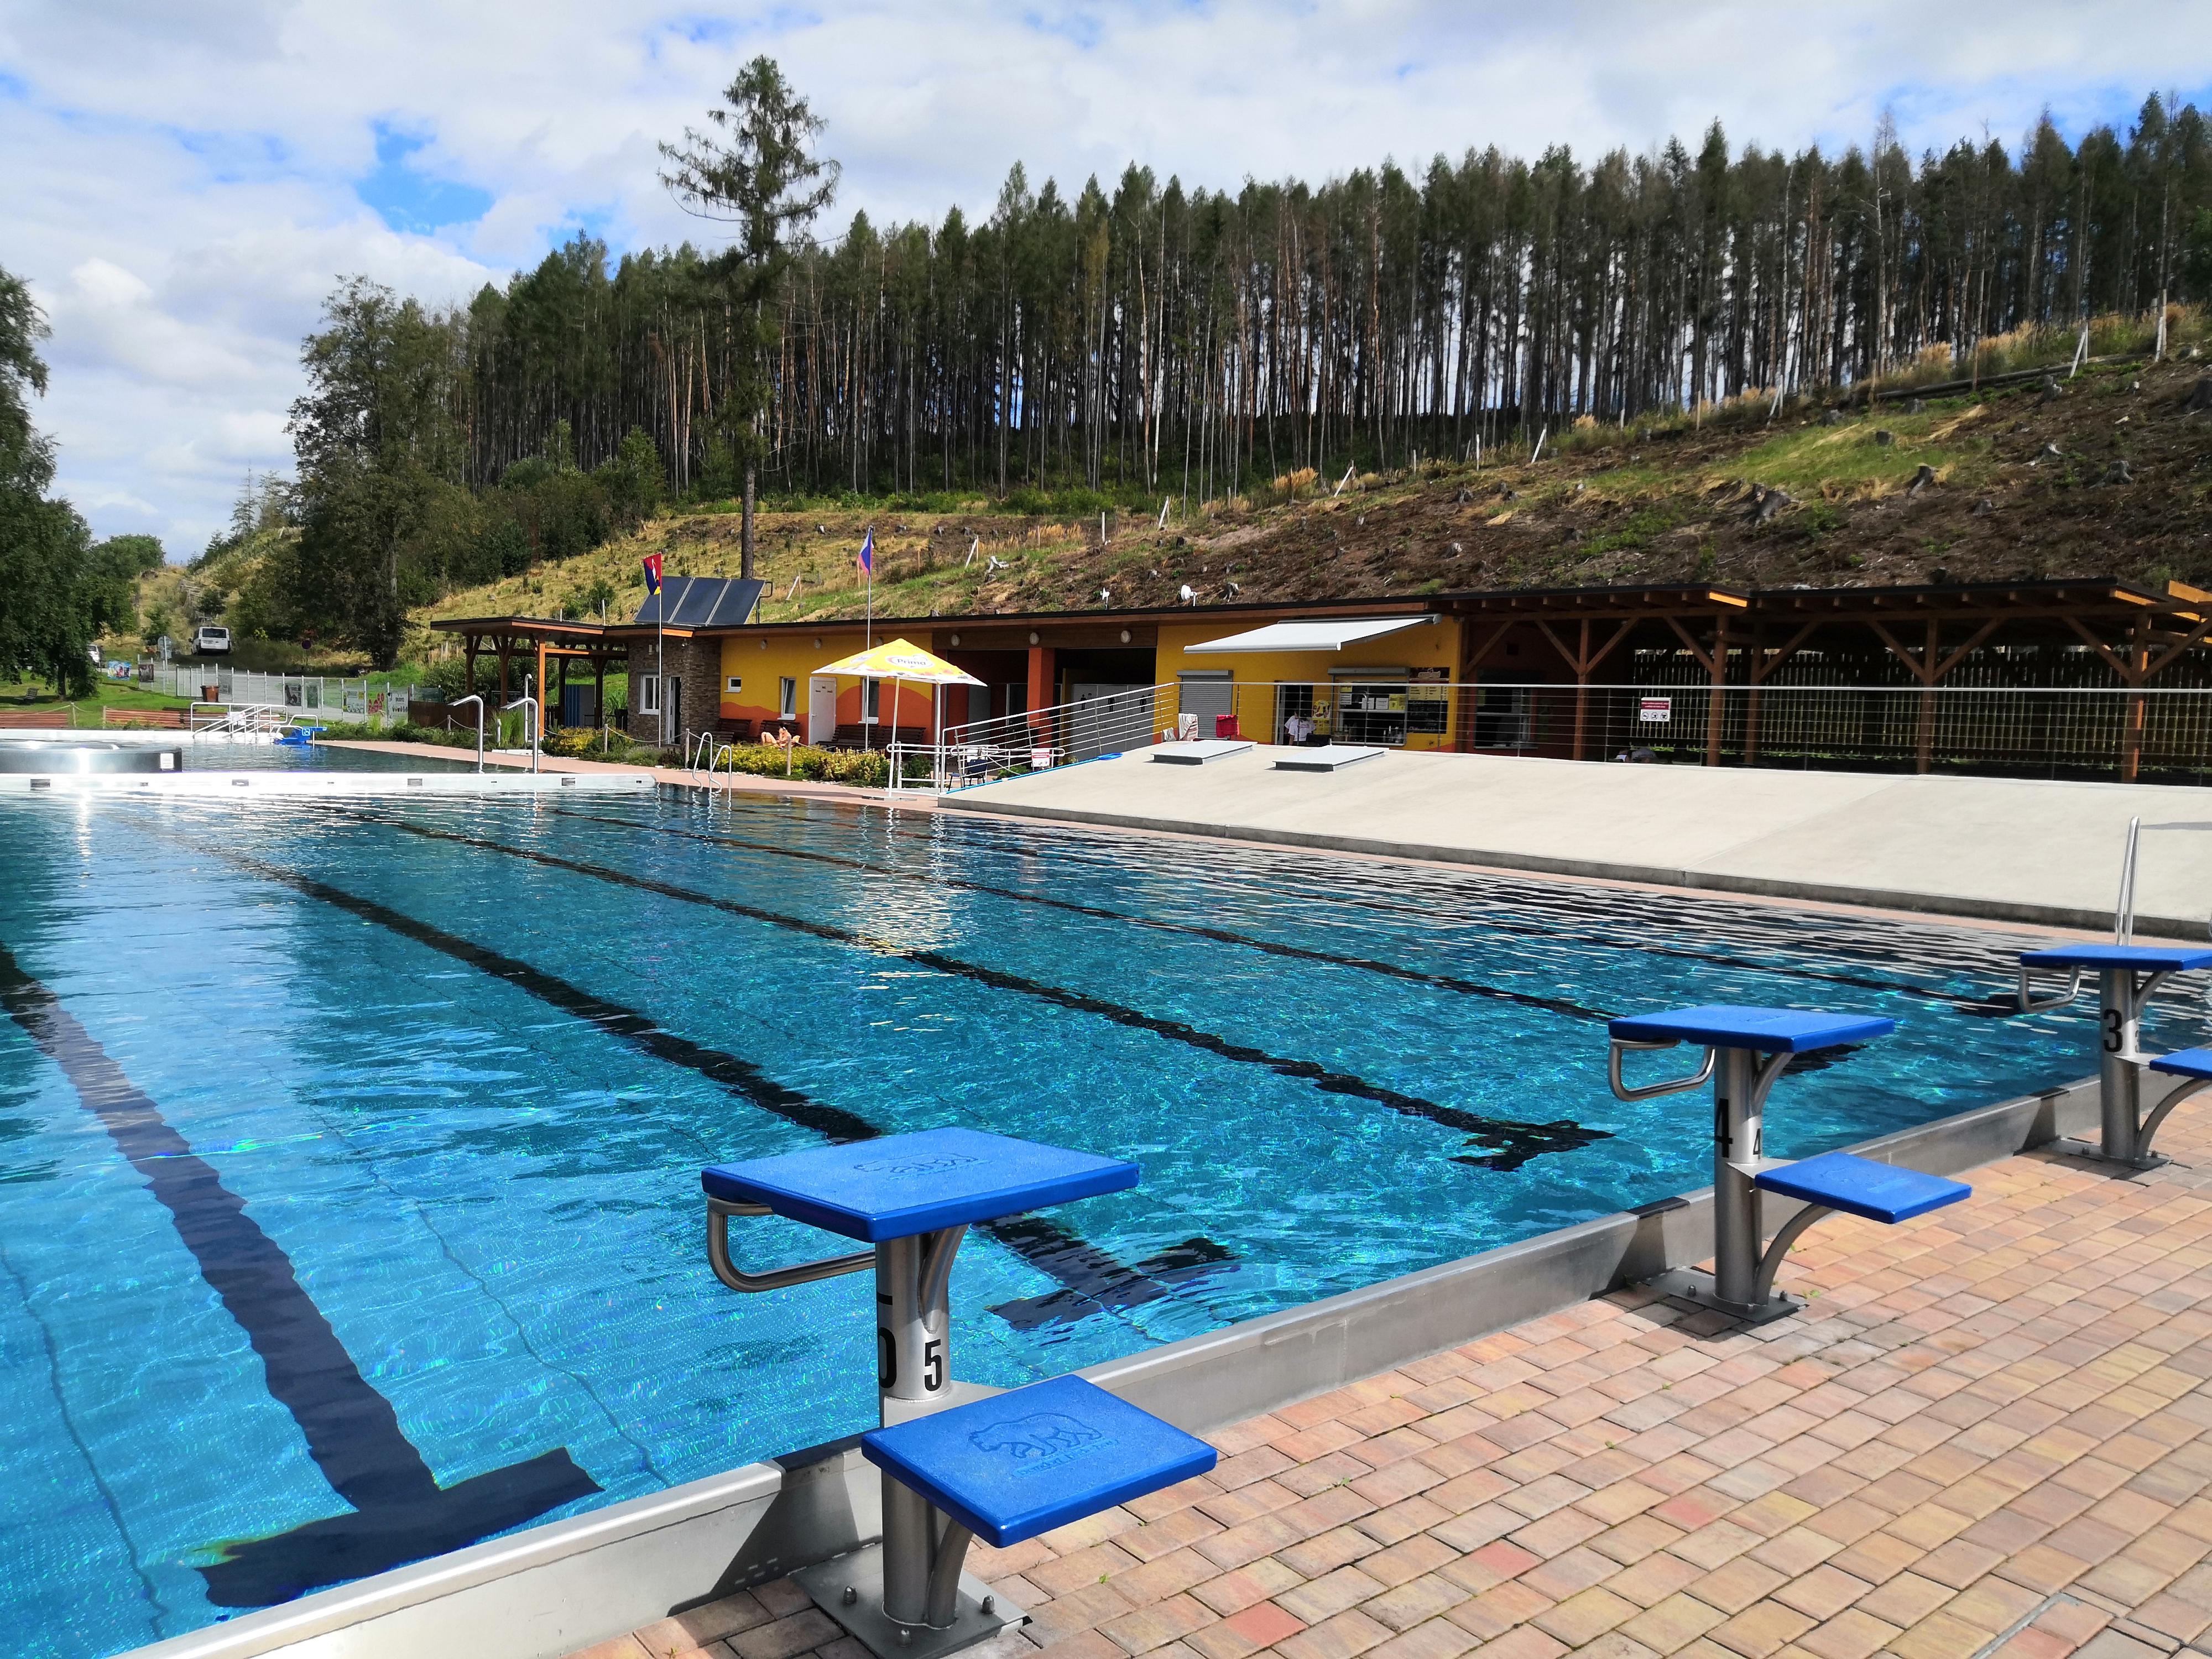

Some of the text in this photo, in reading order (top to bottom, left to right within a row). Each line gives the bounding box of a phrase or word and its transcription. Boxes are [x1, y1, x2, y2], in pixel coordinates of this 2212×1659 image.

[2104, 1009, 2123, 1052] 3
[1714, 1098, 1734, 1158] 4
[924, 1339, 942, 1391] 5
